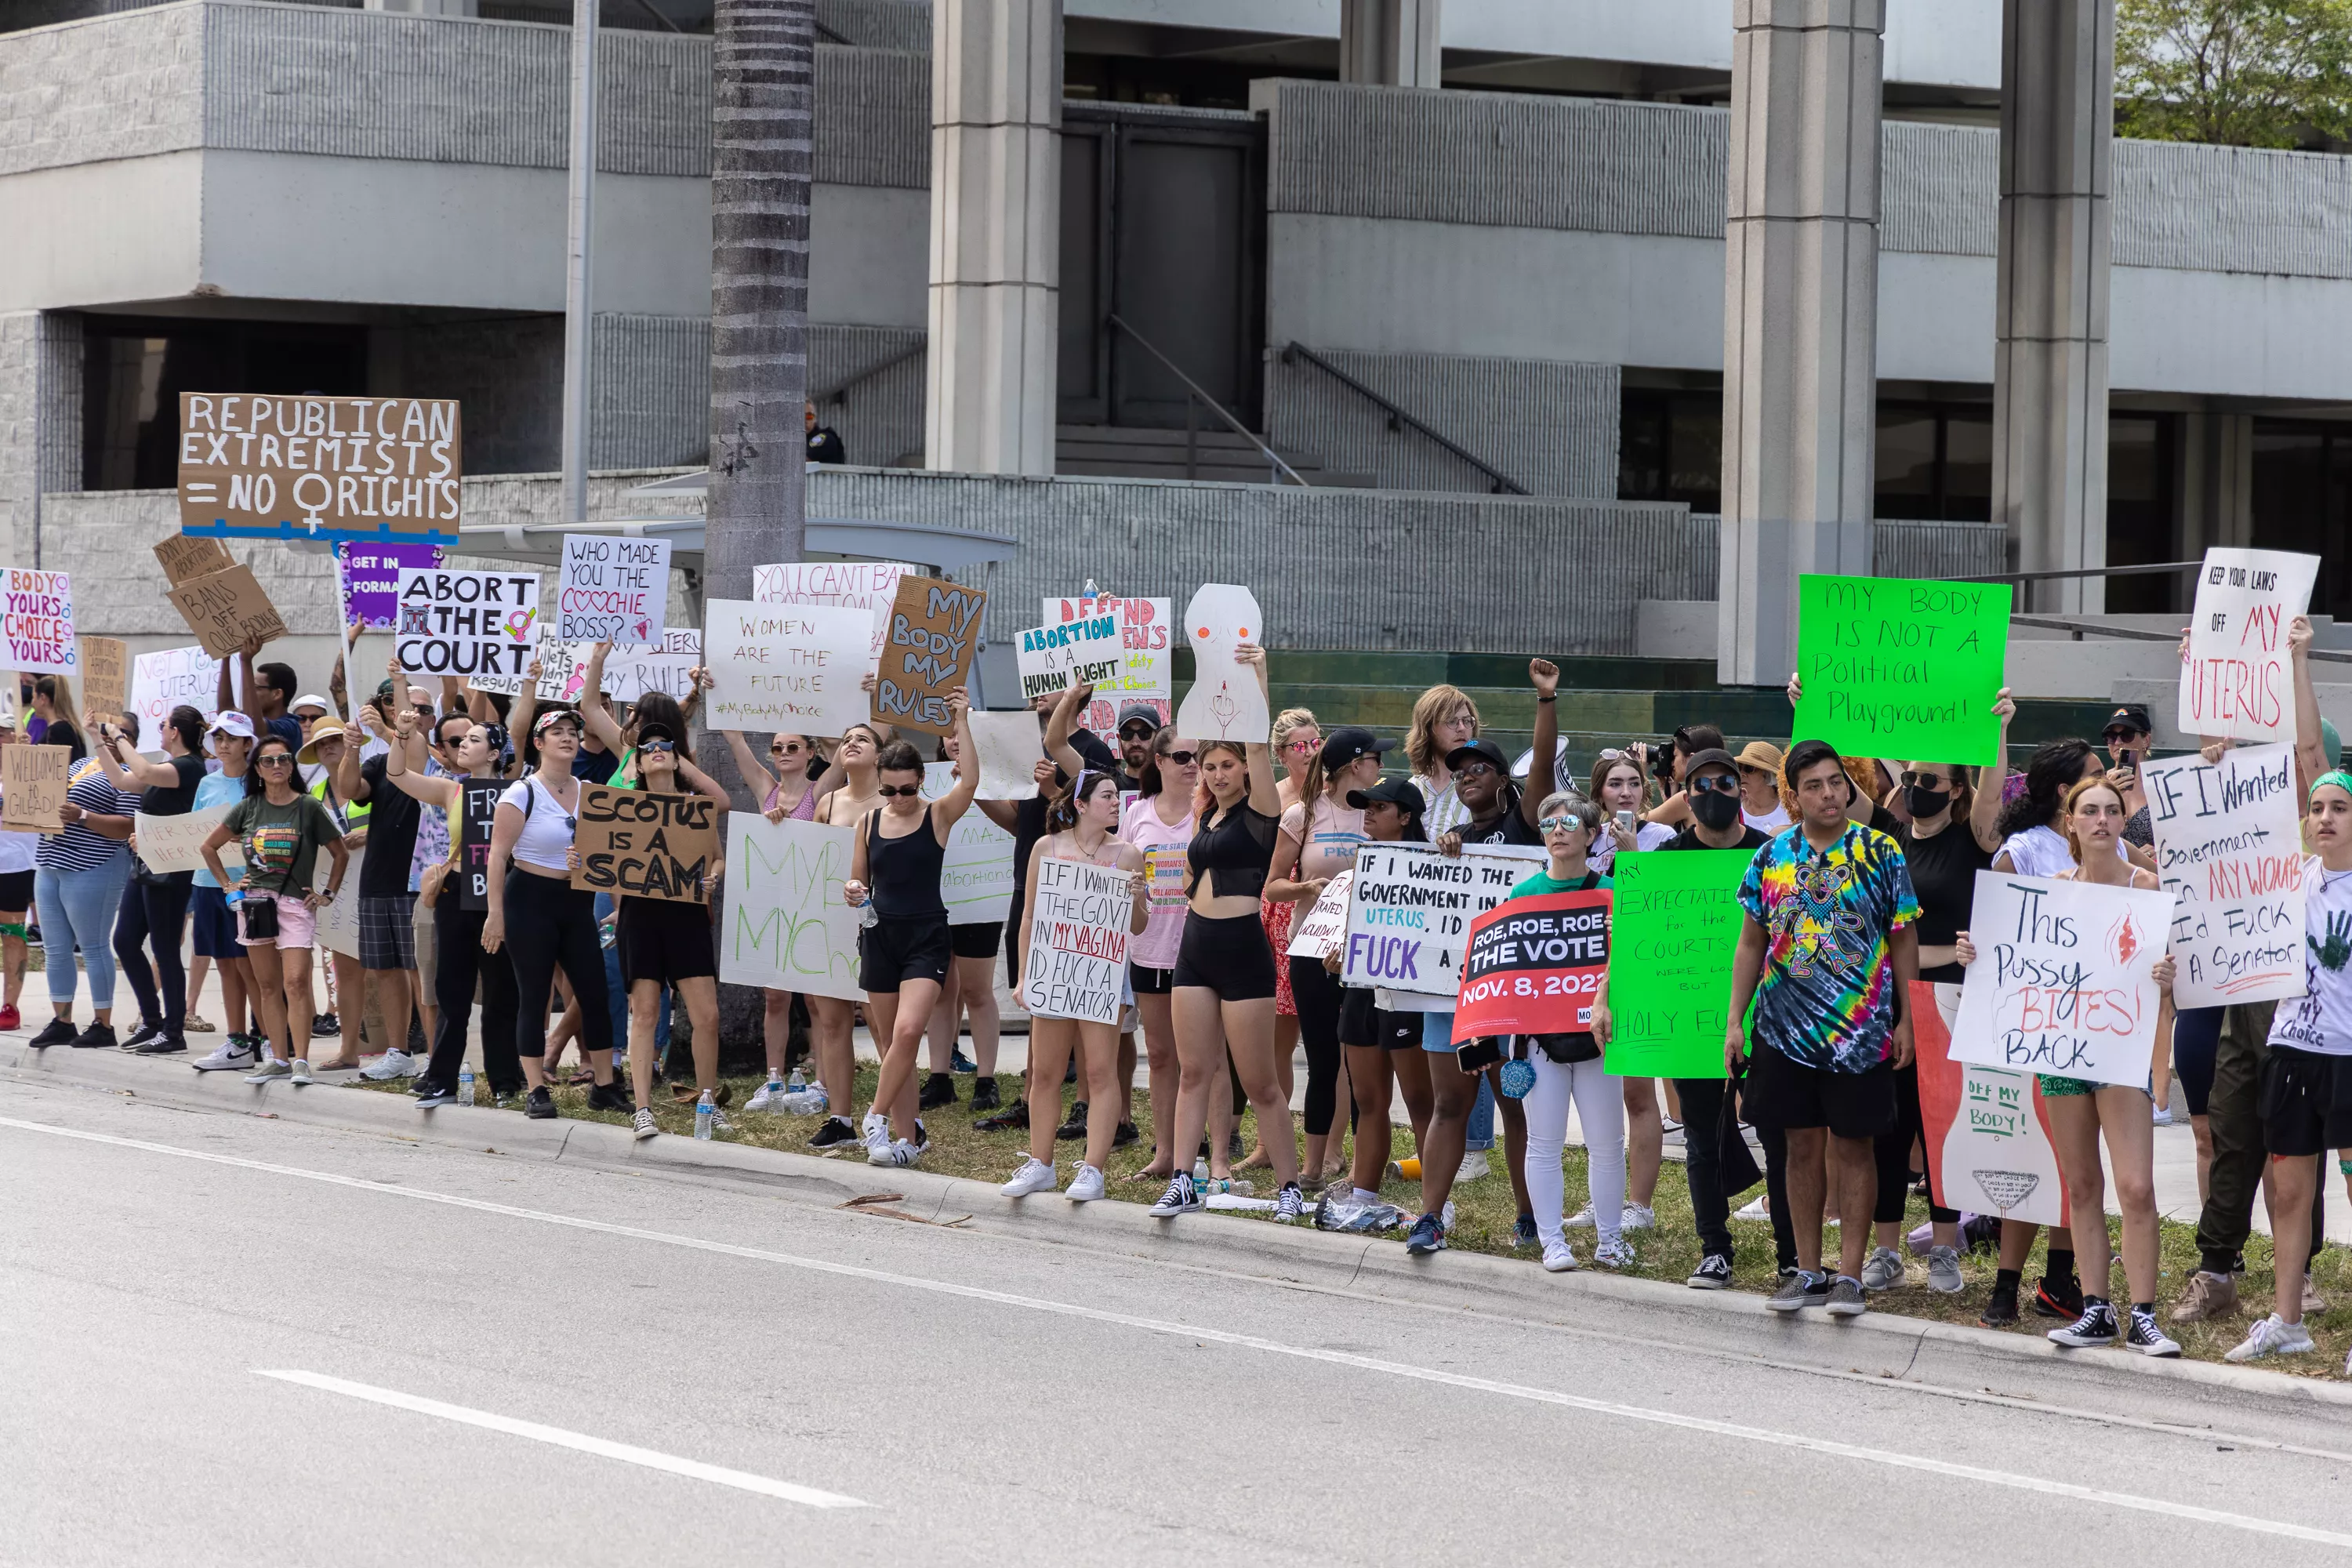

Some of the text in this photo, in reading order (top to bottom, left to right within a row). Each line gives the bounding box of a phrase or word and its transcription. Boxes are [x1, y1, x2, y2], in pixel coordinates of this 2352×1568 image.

[189, 397, 455, 442] REPUBLICAN
[182, 432, 452, 479] EXTREMISTS
[227, 474, 275, 514] NO
[337, 475, 459, 520] RIGHTS
[353, 556, 398, 569] GET IN
[571, 542, 659, 564] WHO MADE
[11, 570, 56, 593] BODY
[354, 581, 398, 593] FORMA
[402, 575, 535, 605] ABORT
[570, 563, 650, 588] YOU THE
[755, 565, 802, 594] YOU
[2208, 566, 2278, 592] KEEP YOUR LAWS
[5, 593, 60, 617] YOURS
[180, 579, 238, 620] BANS
[927, 586, 982, 637] MY
[1825, 583, 1982, 616] MY BODY
[5, 614, 64, 643] CHOICE
[209, 608, 281, 651] OUR BODIES
[212, 606, 238, 628] OFF
[434, 607, 501, 636] THE
[563, 615, 624, 640] BOSS?
[740, 616, 815, 637] WOMEN
[2212, 603, 2281, 652] OFF MY
[891, 614, 966, 661] BODY
[1024, 615, 1115, 653] ABORTION
[1835, 619, 1980, 653] IS NOT A
[9, 639, 64, 664] YOURS
[397, 640, 531, 674] COURT
[734, 647, 833, 667] ARE THE
[1044, 648, 1075, 669] IS A
[636, 664, 688, 696] RULE
[903, 652, 957, 688] MY
[1023, 659, 1119, 697] HUMAN RIGHT
[1812, 652, 1928, 684] Political
[751, 675, 823, 694] FUTURE
[2191, 659, 2281, 728] UTERUS
[878, 679, 953, 726] RULES
[10, 750, 64, 782] WELCOME
[583, 790, 713, 829] SCOTUS
[2147, 768, 2183, 822] IF
[2190, 766, 2216, 817] I
[141, 822, 181, 842] HER
[608, 827, 670, 856] IS A
[2160, 824, 2270, 869] Government
[154, 847, 192, 862] HER
[583, 853, 706, 902] SCAM
[745, 833, 825, 911] MY
[1041, 862, 1131, 899] IF I WANTED
[1361, 855, 1514, 887] IF I WANTED THE
[1620, 862, 1641, 884] MY
[2209, 859, 2241, 902] MY
[2244, 852, 2303, 896] WOMB
[1322, 877, 1347, 898] IF
[1359, 881, 1497, 910] GOVERNMENT IN
[1620, 887, 1737, 916] EXPECTATI
[1040, 892, 1131, 932] THE GOVT
[1441, 914, 1462, 935] I'D
[1665, 909, 1728, 931] for the
[735, 903, 798, 974] MY
[1034, 920, 1125, 962] IN MY VAGINA
[1474, 913, 1604, 950] ROE, ROE, ROE
[1347, 933, 1421, 980] FUCK
[1439, 949, 1450, 967] A
[1471, 941, 1518, 974] THE
[1523, 935, 1605, 962] VOTE
[1635, 937, 1730, 961] COURTS
[1052, 951, 1098, 987] FUCK
[1099, 963, 1111, 991] A
[1656, 967, 1700, 977] WERE
[1994, 944, 2094, 1020] Pussy
[2190, 954, 2204, 984] A
[1031, 982, 1116, 1021] SENATOR
[1461, 978, 1508, 1007] NOV.
[1515, 977, 1539, 1000] 8,
[1679, 982, 1710, 991] BUT
[1615, 1007, 1678, 1040] HOLY
[2018, 983, 2142, 1036] BITES!
[2297, 1002, 2322, 1025] MY
[2281, 1018, 2324, 1047] Choice
[2002, 1029, 2095, 1069] BACK
[1969, 1080, 2020, 1102] OFF MY
